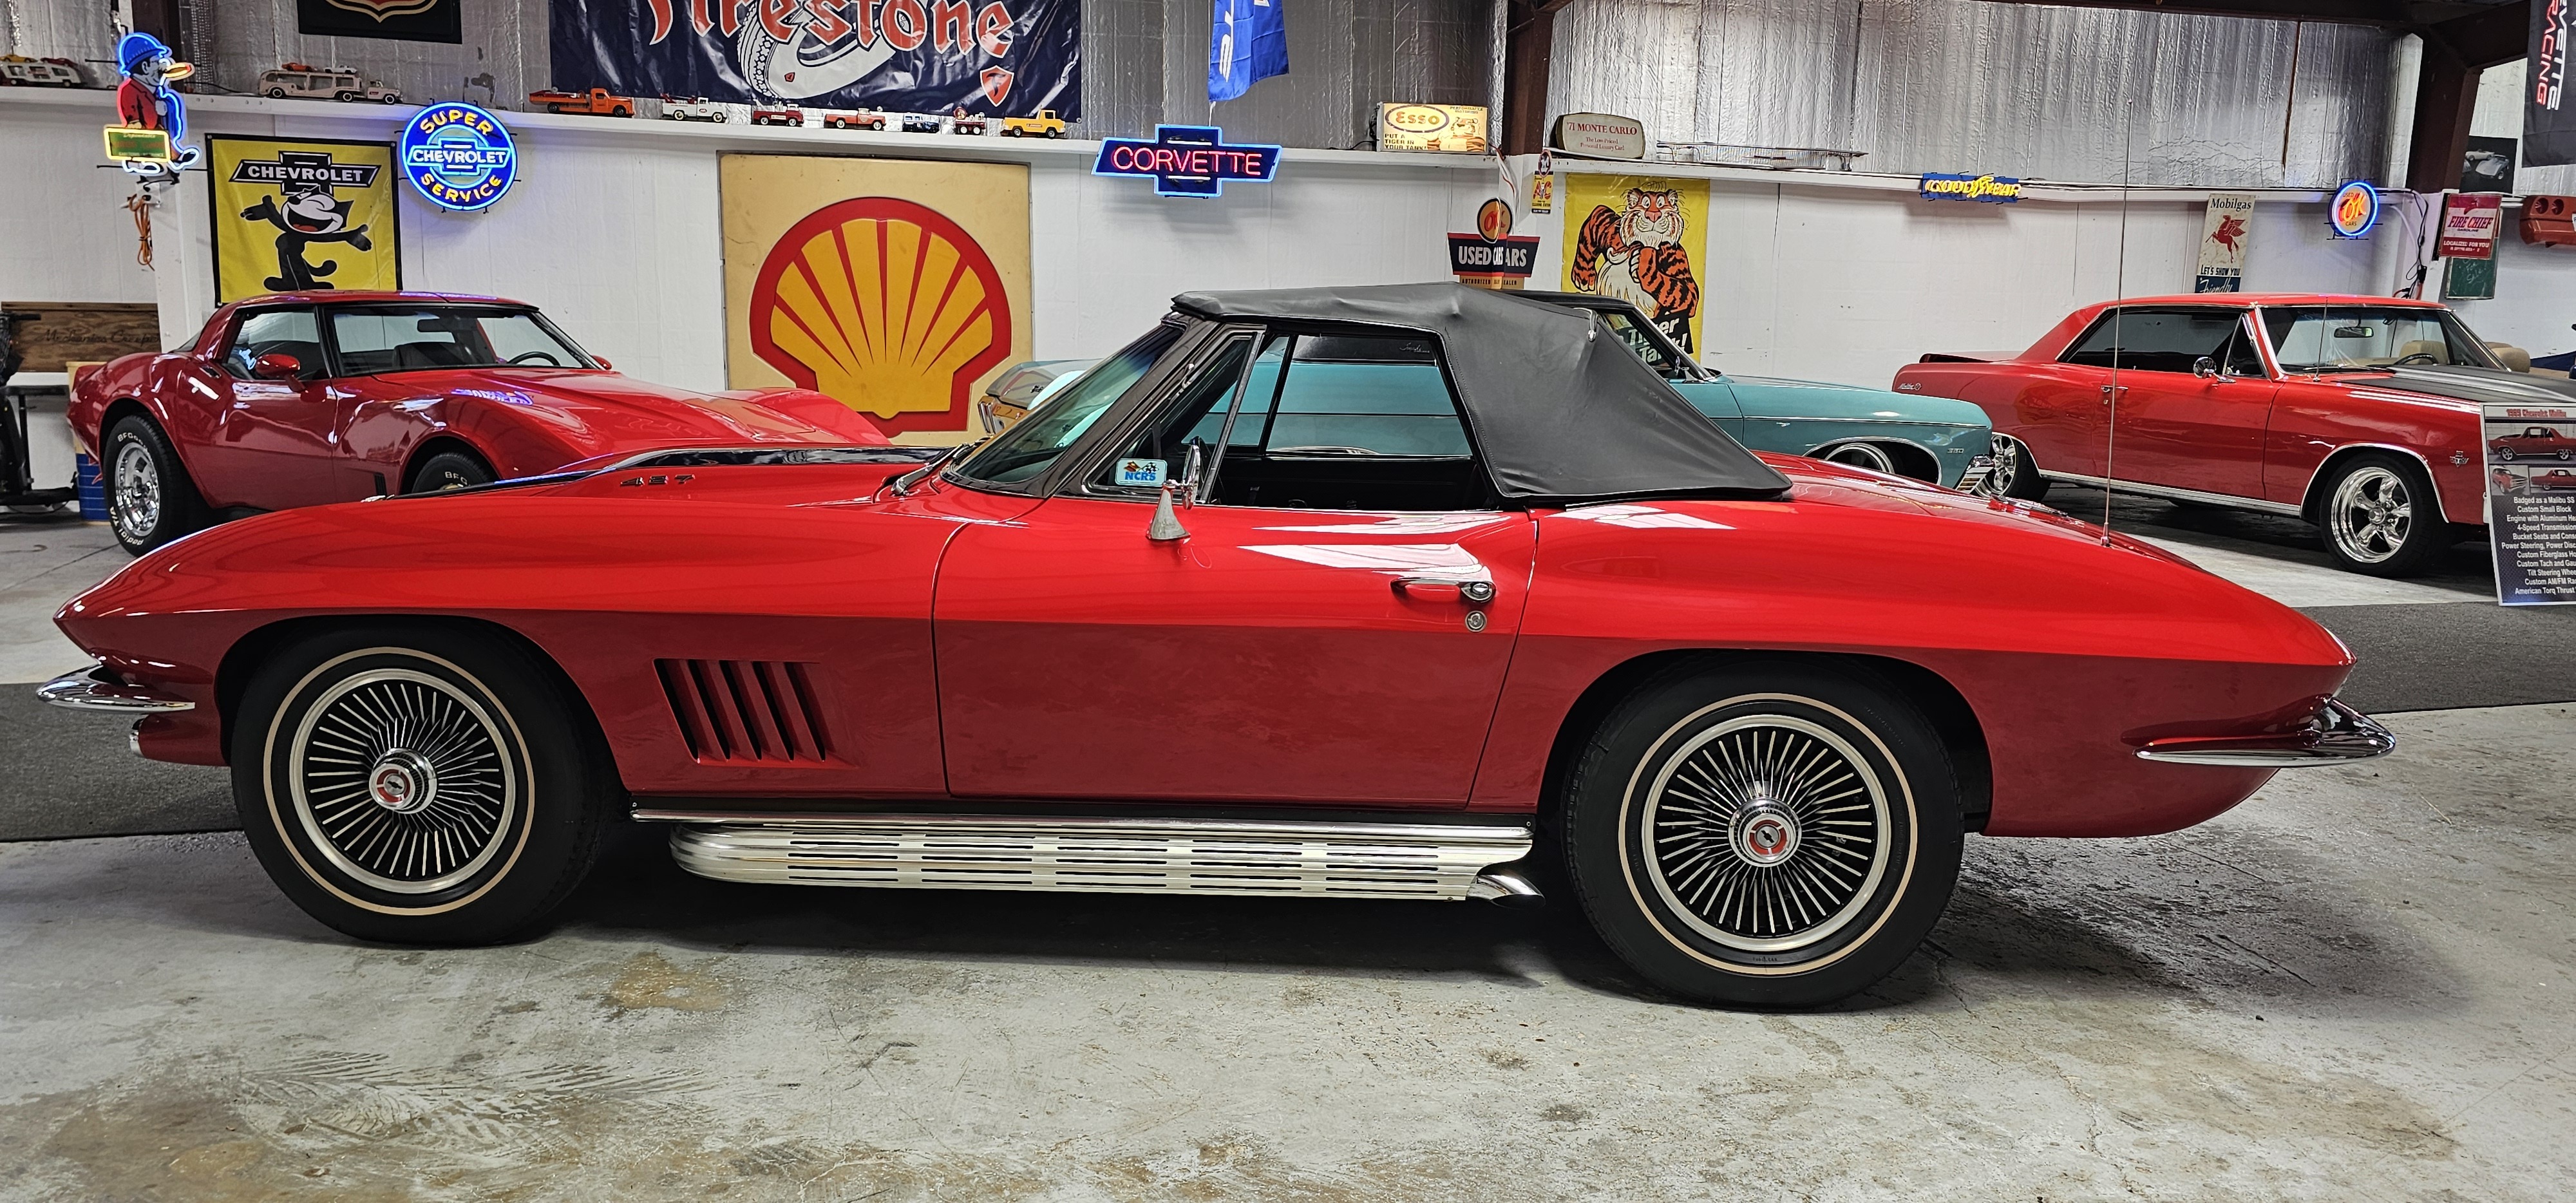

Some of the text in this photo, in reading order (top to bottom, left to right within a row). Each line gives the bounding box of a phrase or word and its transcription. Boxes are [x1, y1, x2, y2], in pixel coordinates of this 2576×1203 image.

[420, 109, 493, 136] SUPER
[1577, 124, 1607, 133] MONTE
[1609, 126, 1637, 135] CARLO
[413, 149, 506, 164] CHEVROLET
[1110, 146, 1262, 176] CORVETTE
[248, 166, 363, 182] CHEVROLET
[421, 173, 502, 202] SERVICE
[2211, 198, 2251, 212] Mobilgas
[2342, 191, 2367, 222] OK
[2448, 216, 2494, 229] FIRE CHIEF
[1459, 245, 1492, 265] USED
[1506, 248, 1527, 267] ARS
[2201, 264, 2214, 275] LET'S
[1124, 471, 1156, 480] NCRS
[2514, 497, 2535, 505] Badged
[2506, 515, 2526, 523] Engine
[2517, 524, 2539, 532] 4-Speed
[2520, 542, 2545, 550] Steering,
[2539, 551, 2568, 559] Fiberglass
[2537, 569, 2561, 577] Steering
[2542, 587, 2556, 595] Torq
